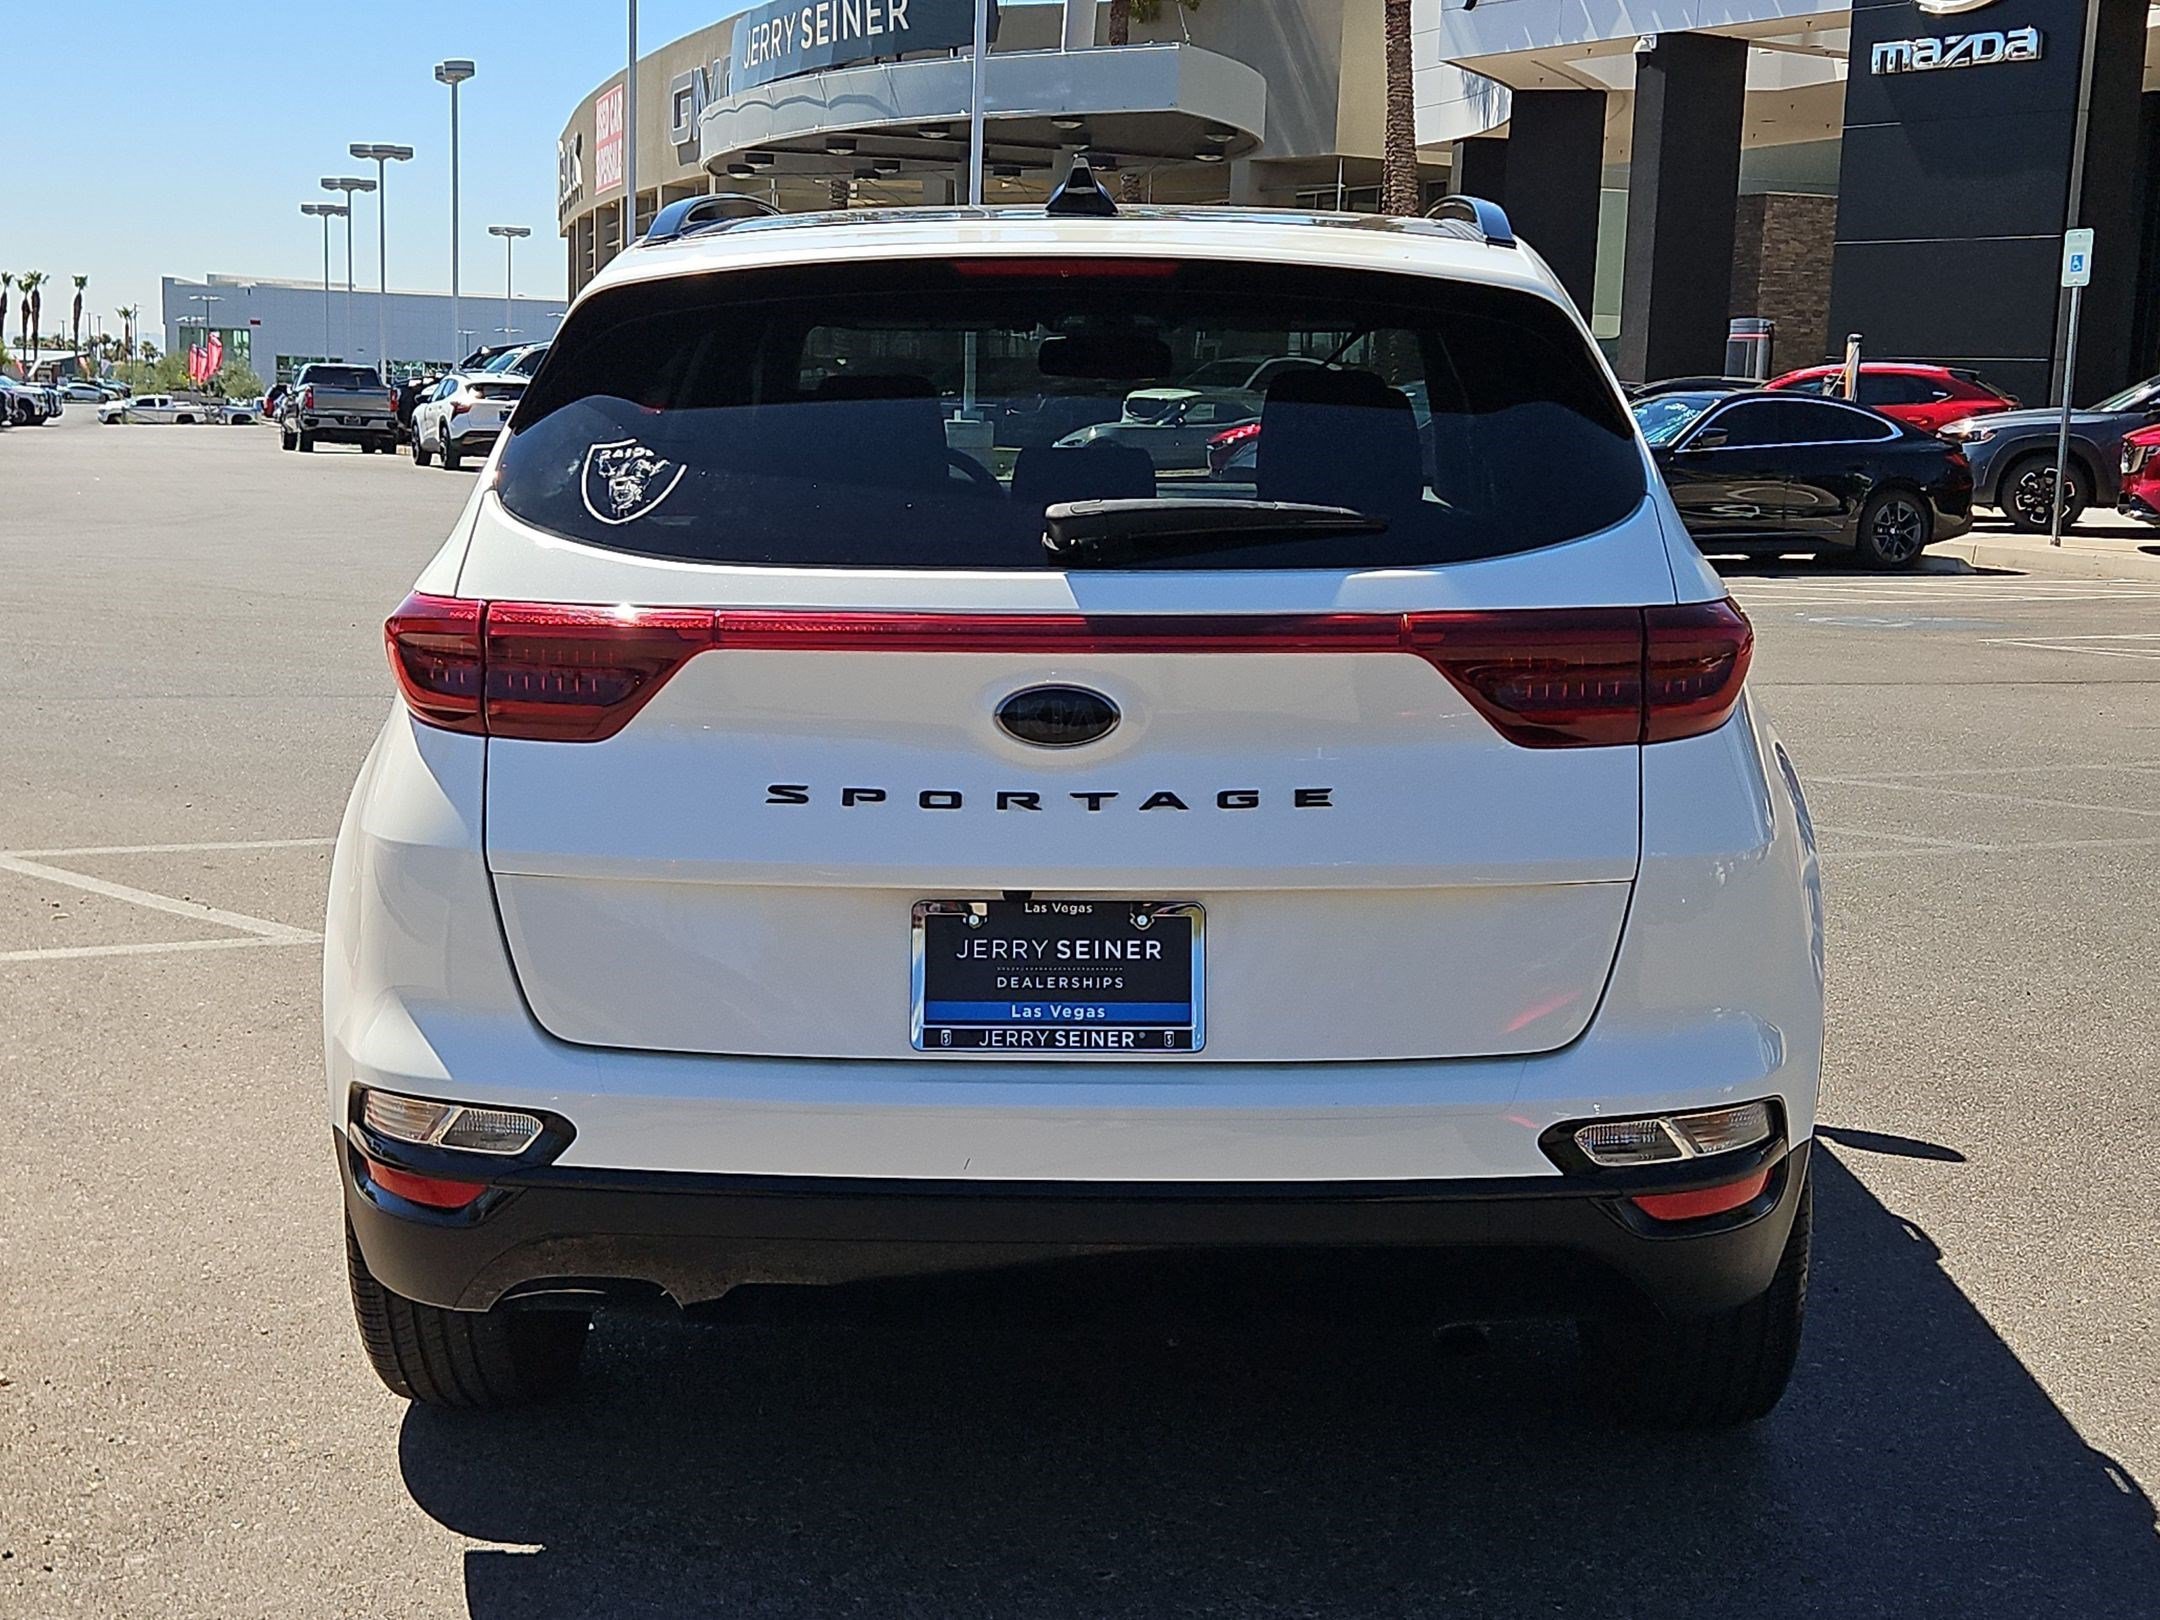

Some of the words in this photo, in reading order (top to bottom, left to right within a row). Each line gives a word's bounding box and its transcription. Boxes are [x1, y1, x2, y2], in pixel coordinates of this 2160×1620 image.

[743, 11, 797, 70] JERRY
[800, 0, 910, 50] SEINER
[766, 784, 1333, 812] SPORTAGE
[1024, 903, 1047, 914] Las
[1052, 903, 1093, 915] Vegas
[956, 939, 1049, 959] JERRY
[1056, 939, 1162, 960] SEINER
[996, 977, 1124, 989] DEALERSHIPS
[1011, 1005, 1043, 1018] Las
[1051, 1005, 1106, 1020] Vegas
[979, 1031, 1049, 1046] JERRY
[1054, 1031, 1135, 1047] SEINER
